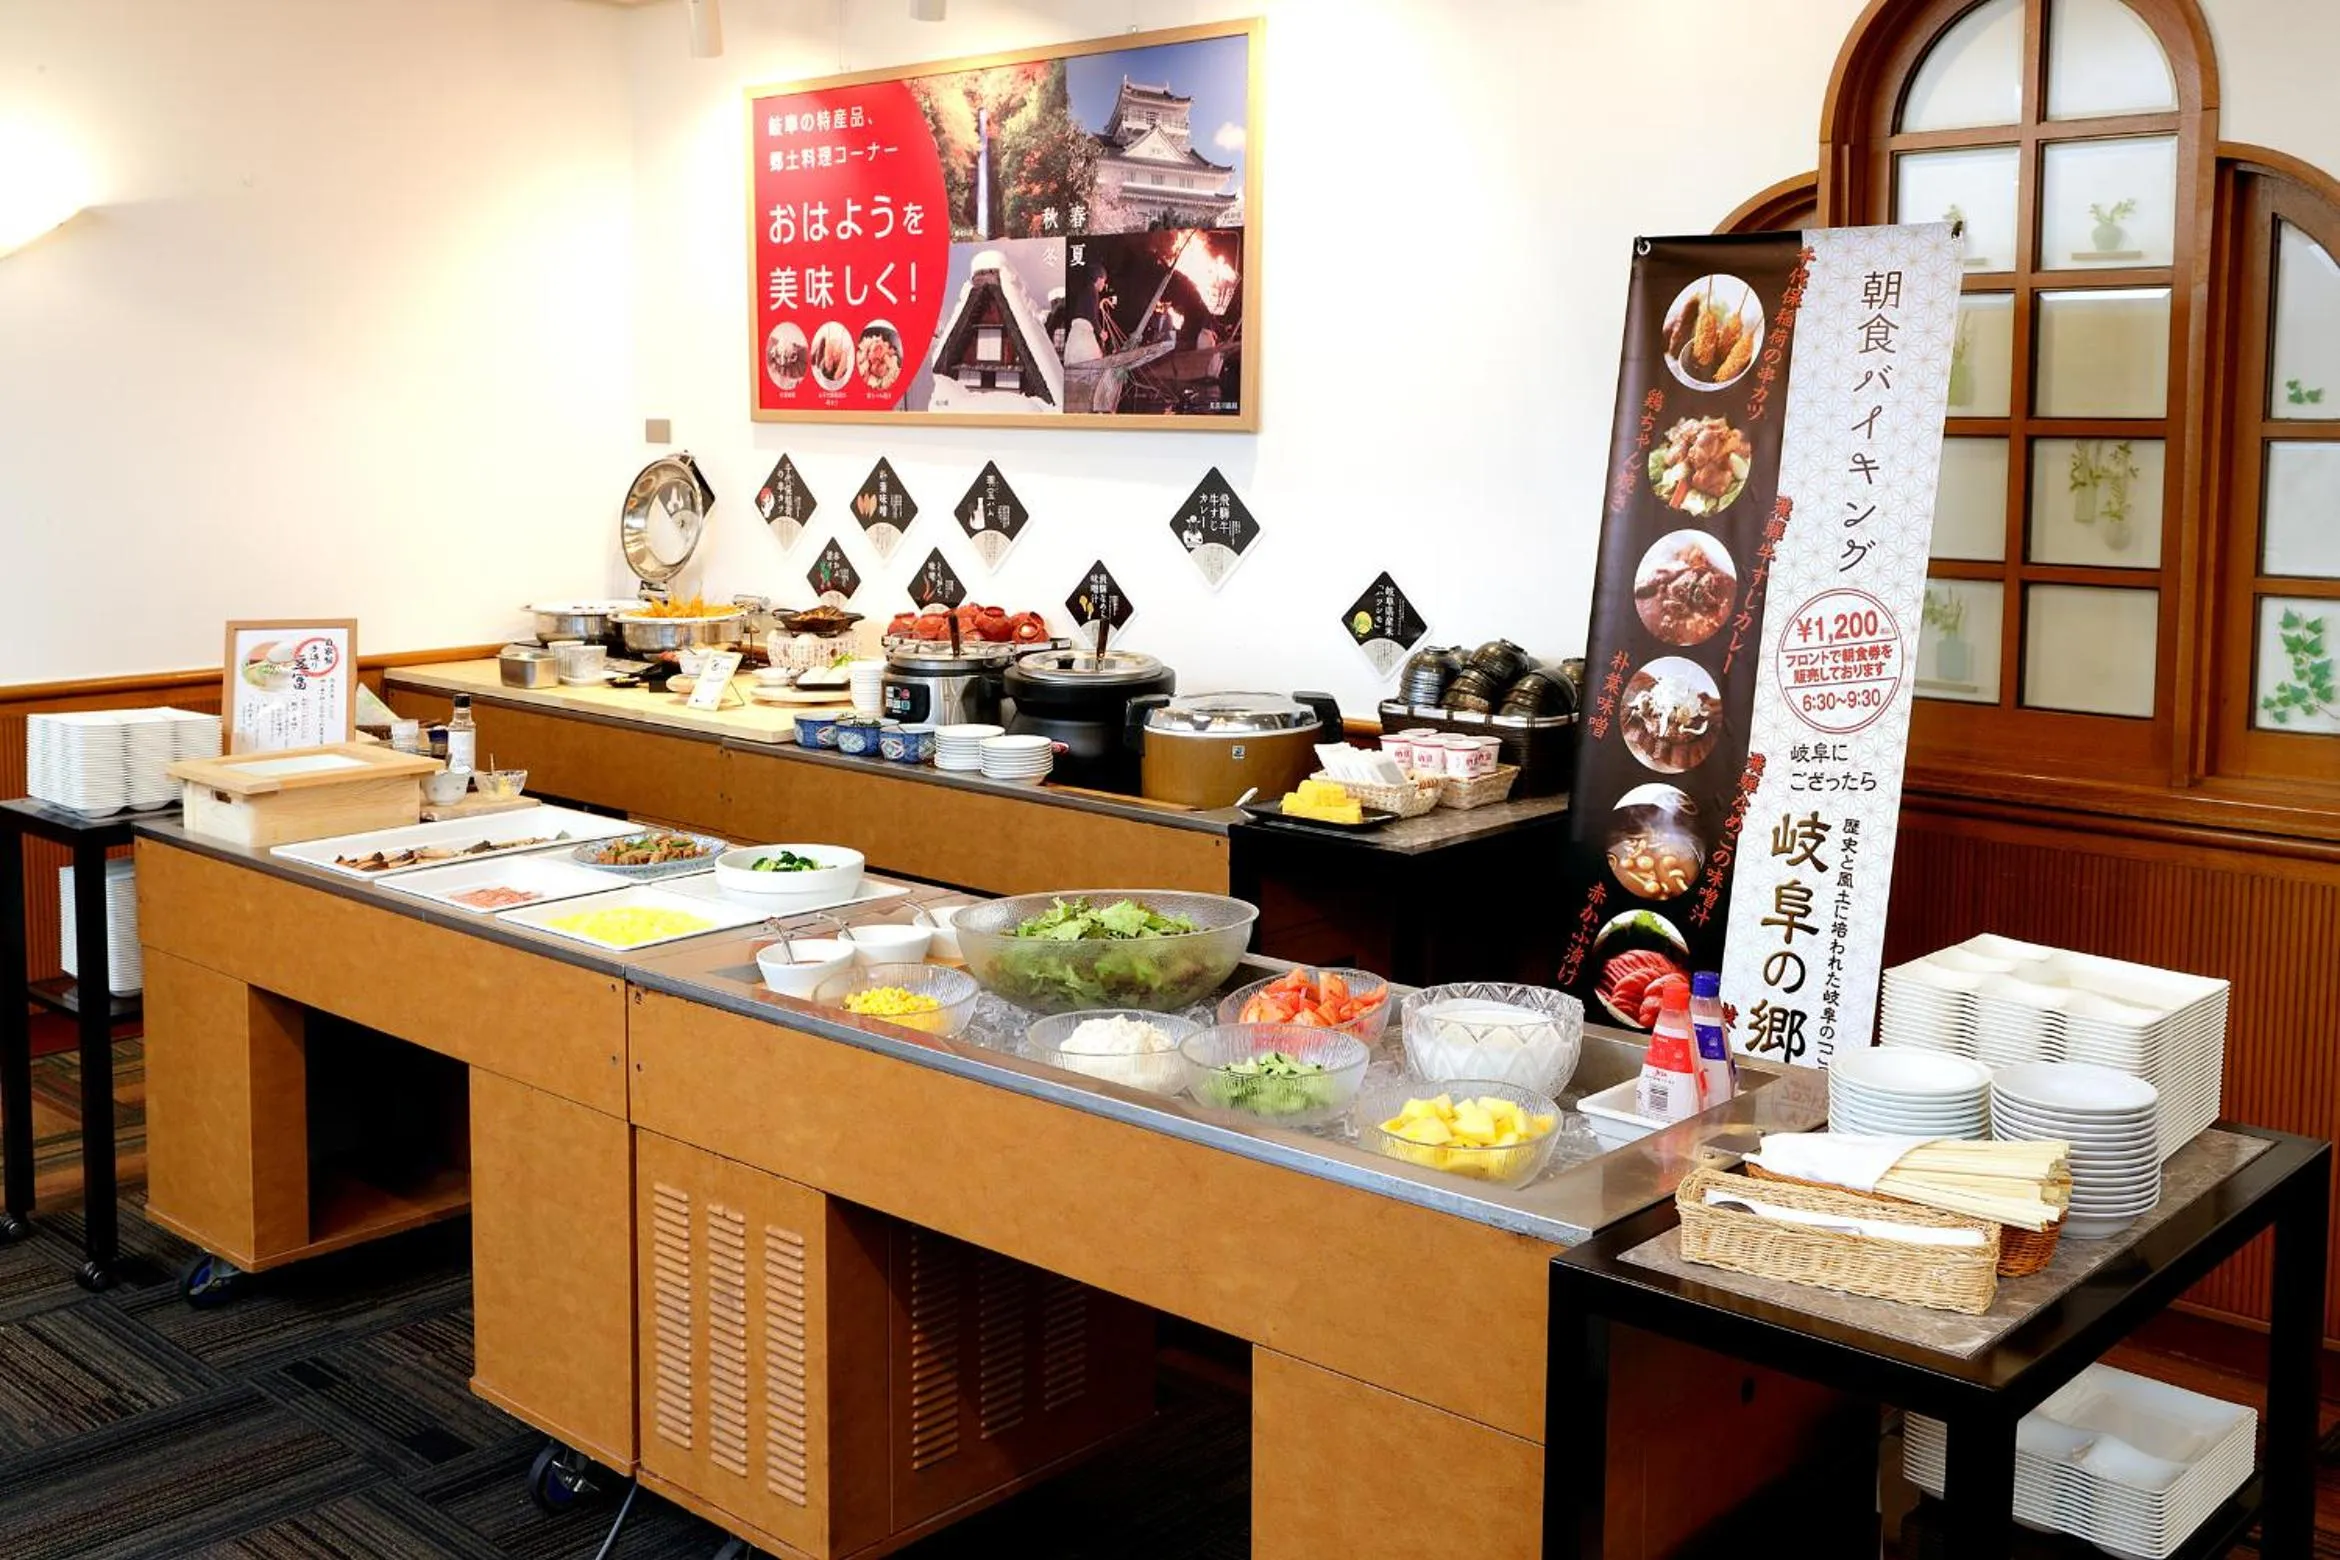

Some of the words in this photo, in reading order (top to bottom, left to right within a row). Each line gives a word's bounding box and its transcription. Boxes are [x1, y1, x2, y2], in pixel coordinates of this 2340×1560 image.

[769, 141, 898, 172] 郷土料理コーナー
[768, 195, 924, 244] おはようを
[1042, 206, 1059, 230] 秋
[1070, 205, 1087, 229] 春
[1070, 243, 1086, 267] 夏
[768, 261, 917, 311] 美味しく！
[1839, 270, 1903, 572] 朝食バイキング
[1199, 492, 1209, 529] カレー
[1796, 609, 1879, 644] ¥1,200
[1785, 643, 1893, 669] フロントで朝食券を
[1793, 660, 1886, 684] 販売しております
[1588, 649, 1630, 740] 朴葉味噌
[1790, 742, 1849, 764] 岐阜に
[1790, 770, 1878, 792] ござったら
[1745, 810, 1832, 1064] 岐阜の郷
